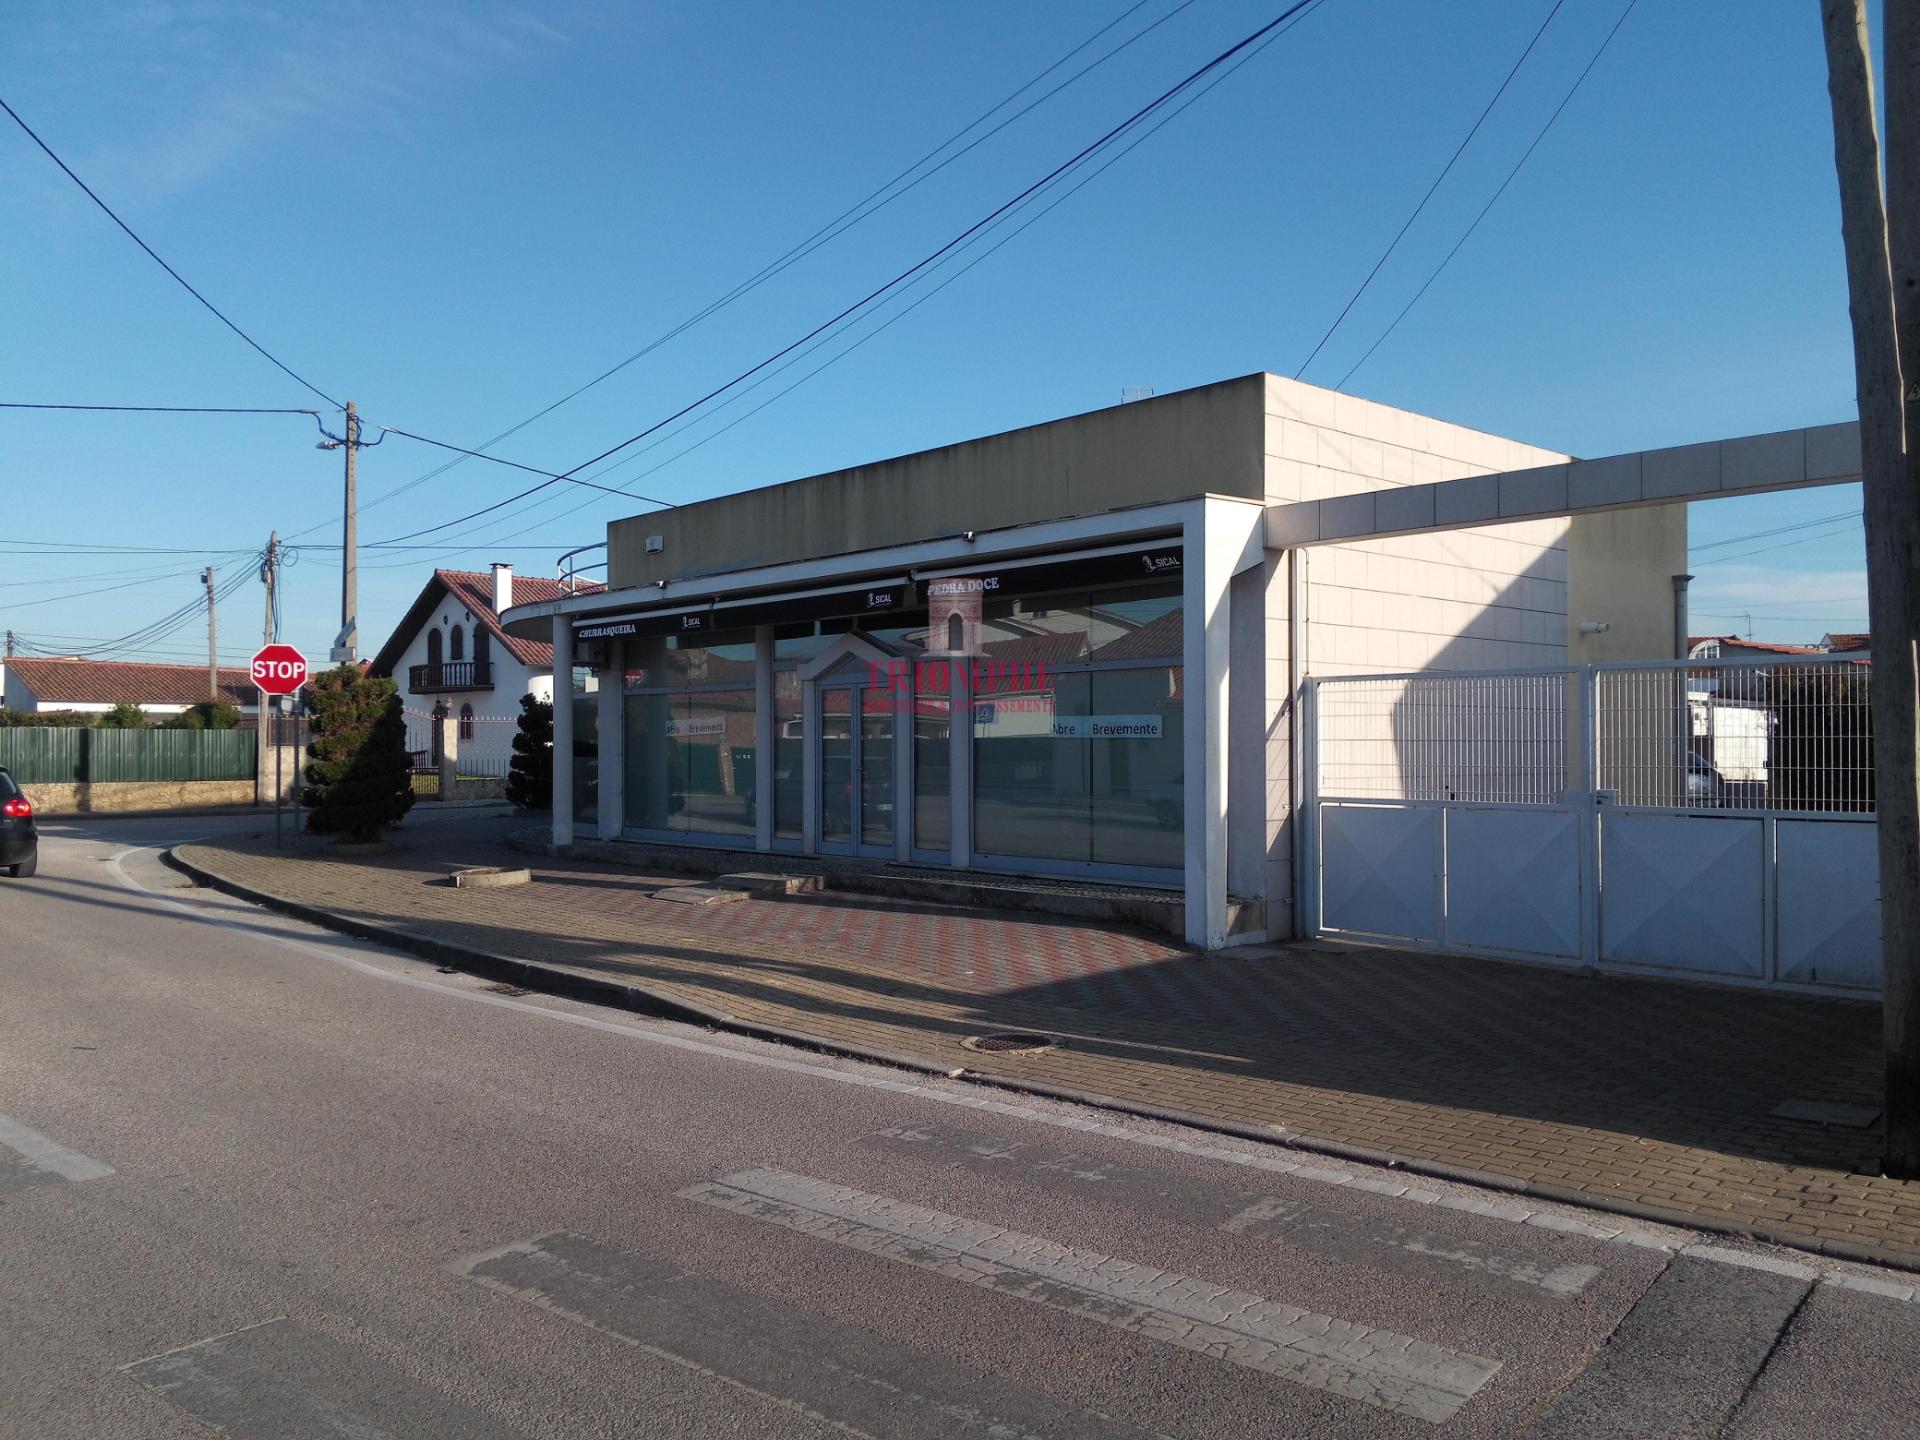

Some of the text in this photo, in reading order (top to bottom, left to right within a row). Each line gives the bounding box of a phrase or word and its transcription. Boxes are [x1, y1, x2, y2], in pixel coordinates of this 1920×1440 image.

[1155, 557, 1181, 568] SICAL
[927, 577, 1000, 596] PEDRA DOCE
[578, 624, 636, 638] CHURRASQUEIRA
[253, 660, 305, 679] STOP
[1092, 723, 1158, 735] Brevemente
